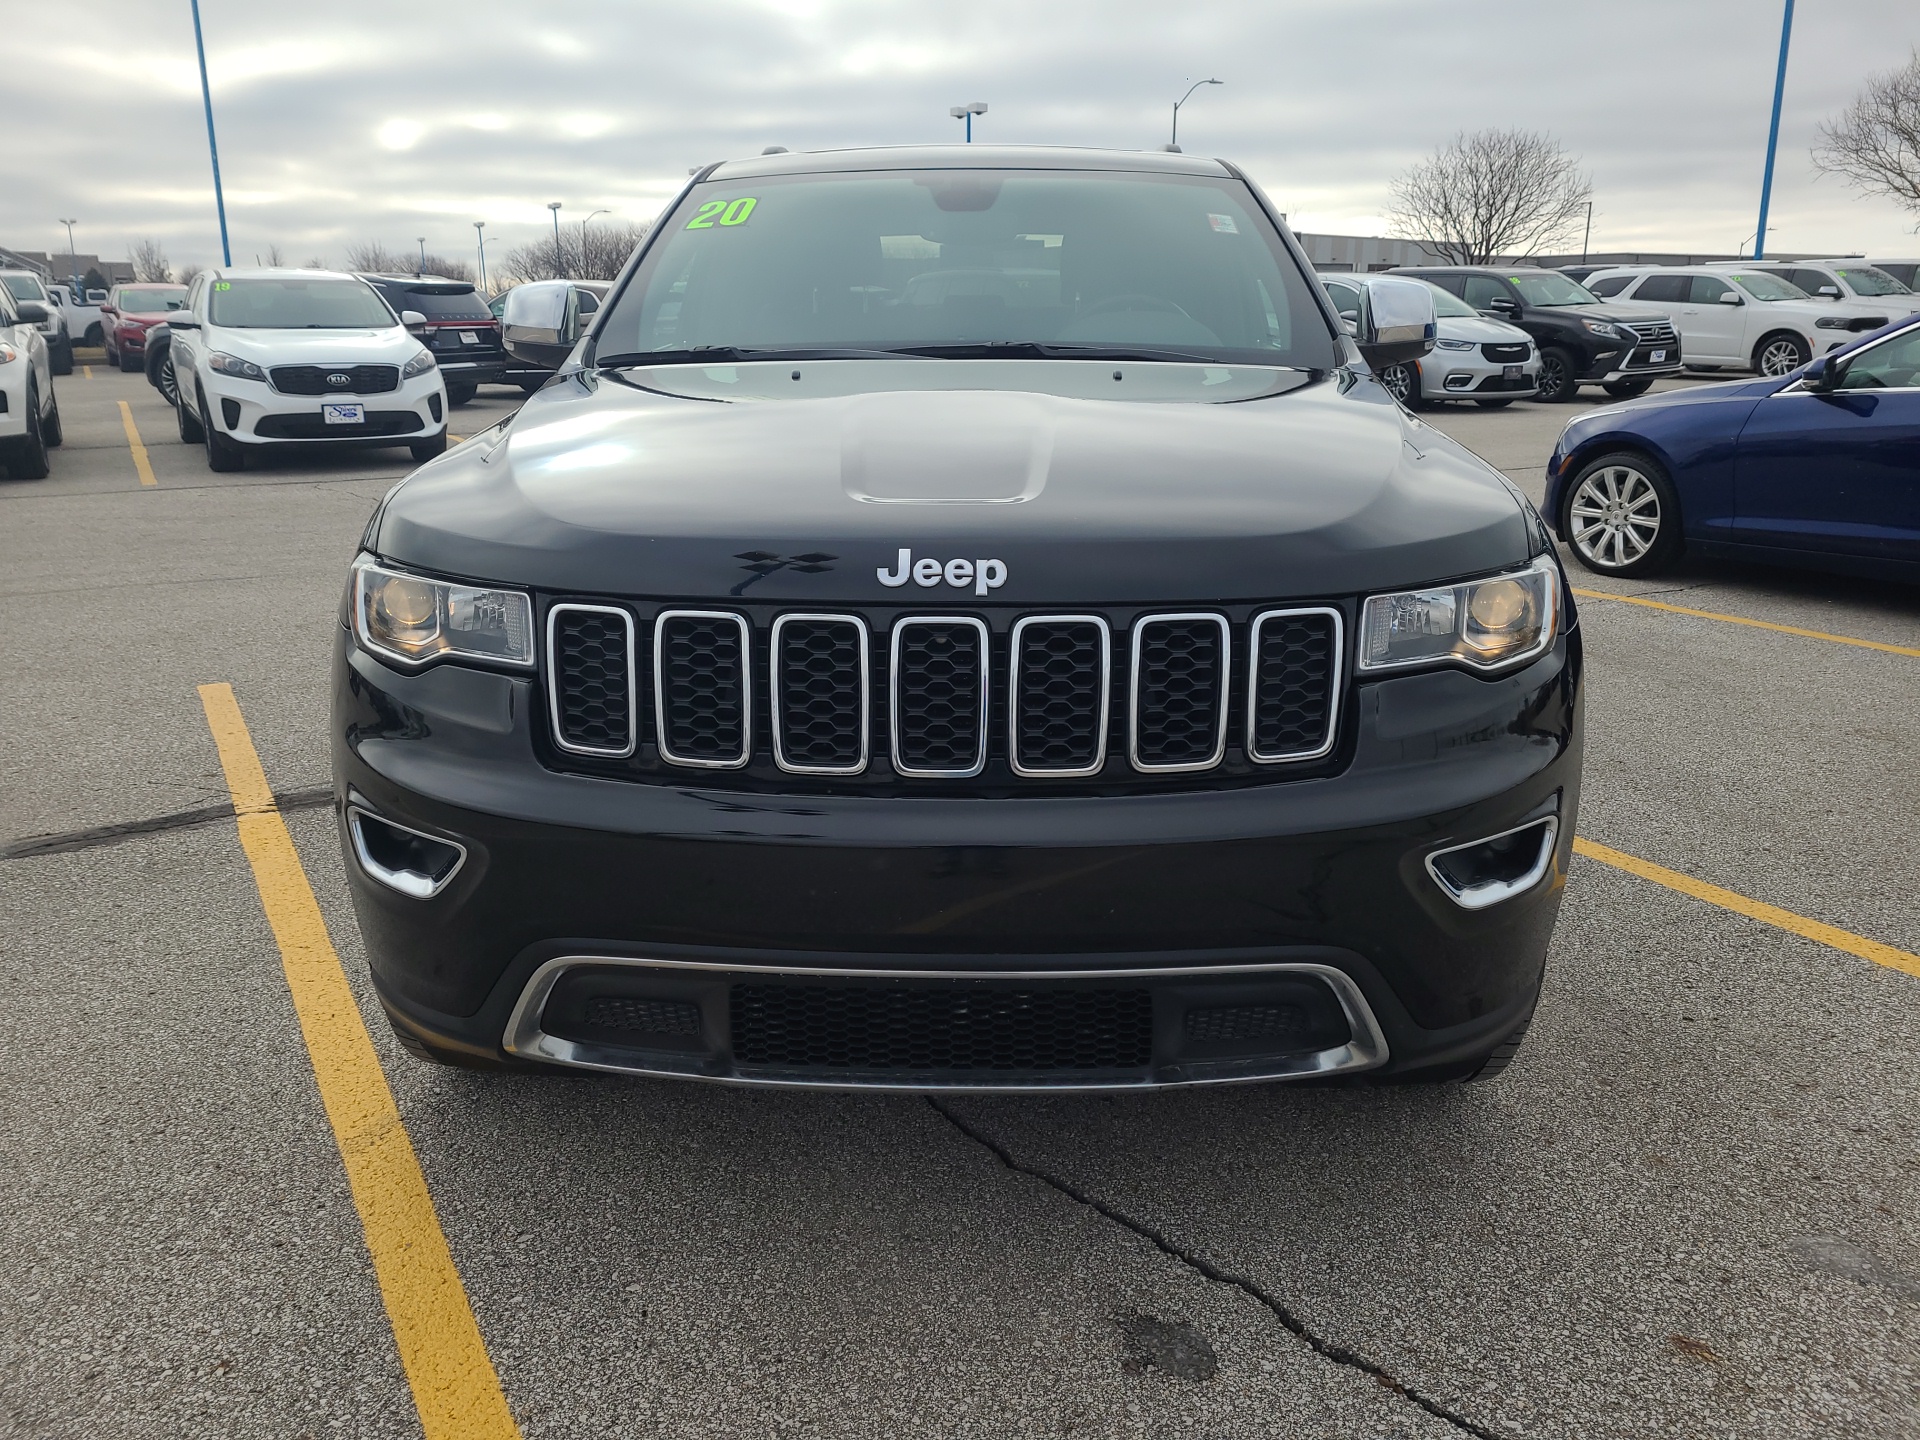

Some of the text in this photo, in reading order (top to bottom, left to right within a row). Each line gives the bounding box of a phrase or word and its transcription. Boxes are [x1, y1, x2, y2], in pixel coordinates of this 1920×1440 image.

[686, 197, 757, 230] 20
[215, 282, 231, 291] 19
[876, 548, 1008, 596] Jeep
